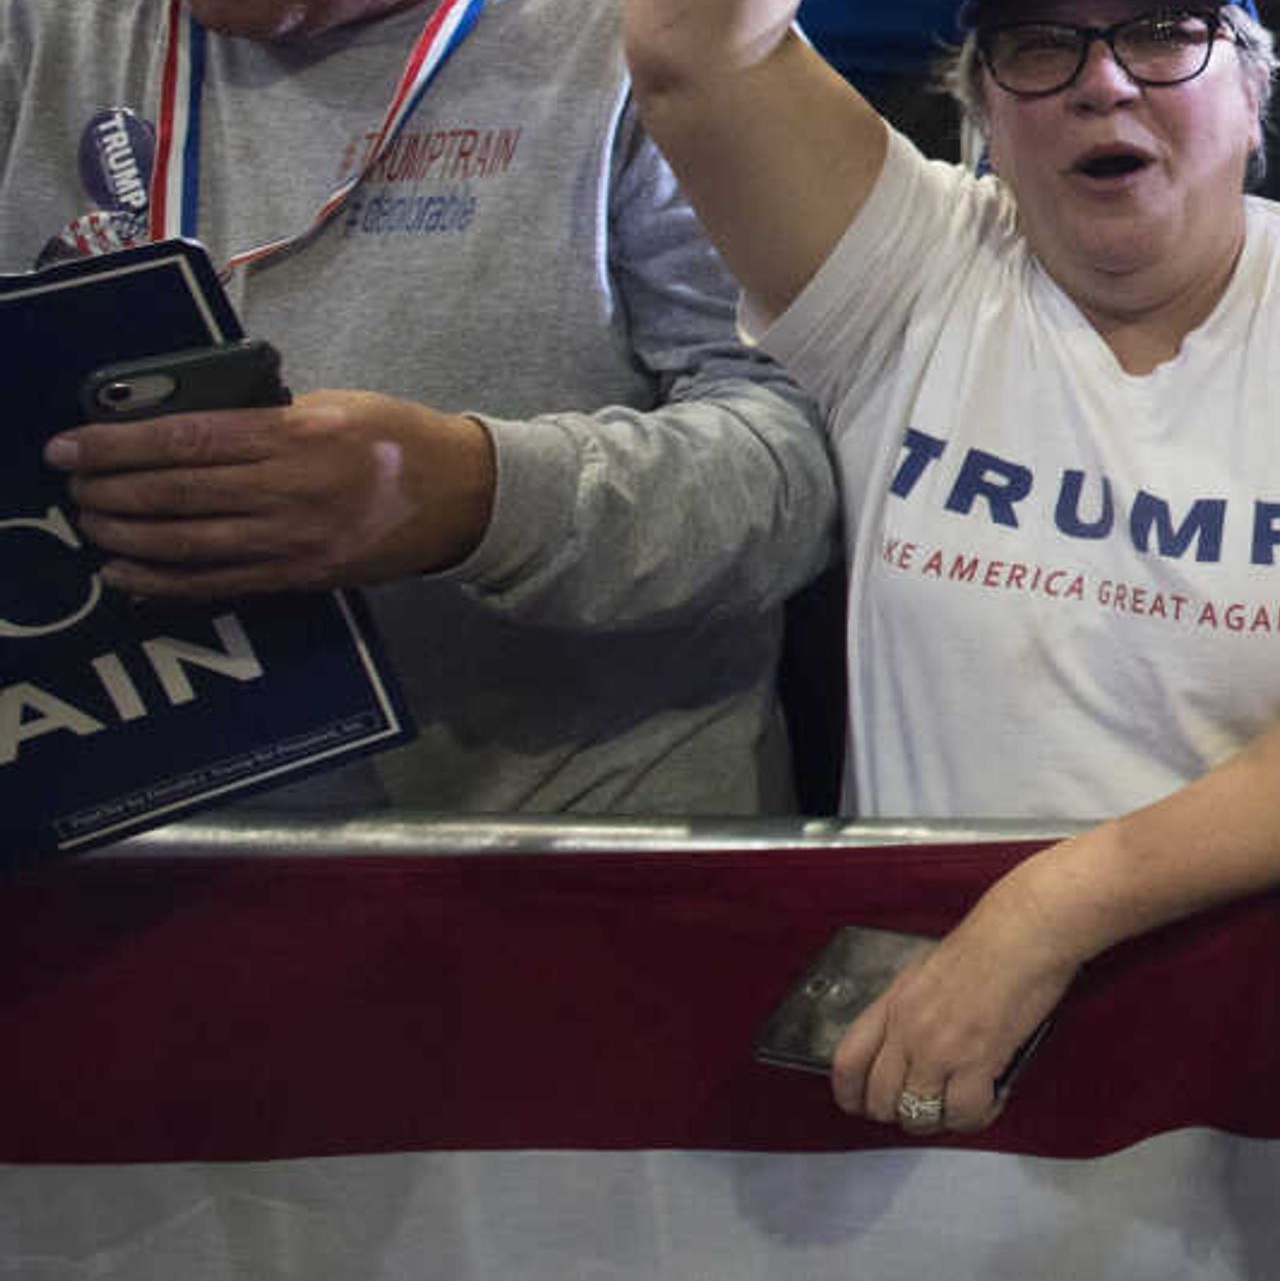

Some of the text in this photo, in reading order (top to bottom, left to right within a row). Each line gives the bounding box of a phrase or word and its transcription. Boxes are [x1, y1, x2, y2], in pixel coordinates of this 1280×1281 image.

[97, 112, 147, 210] TRUMP
[922, 550, 1085, 601] AMERICA
[1099, 580, 1193, 621] GREAT
